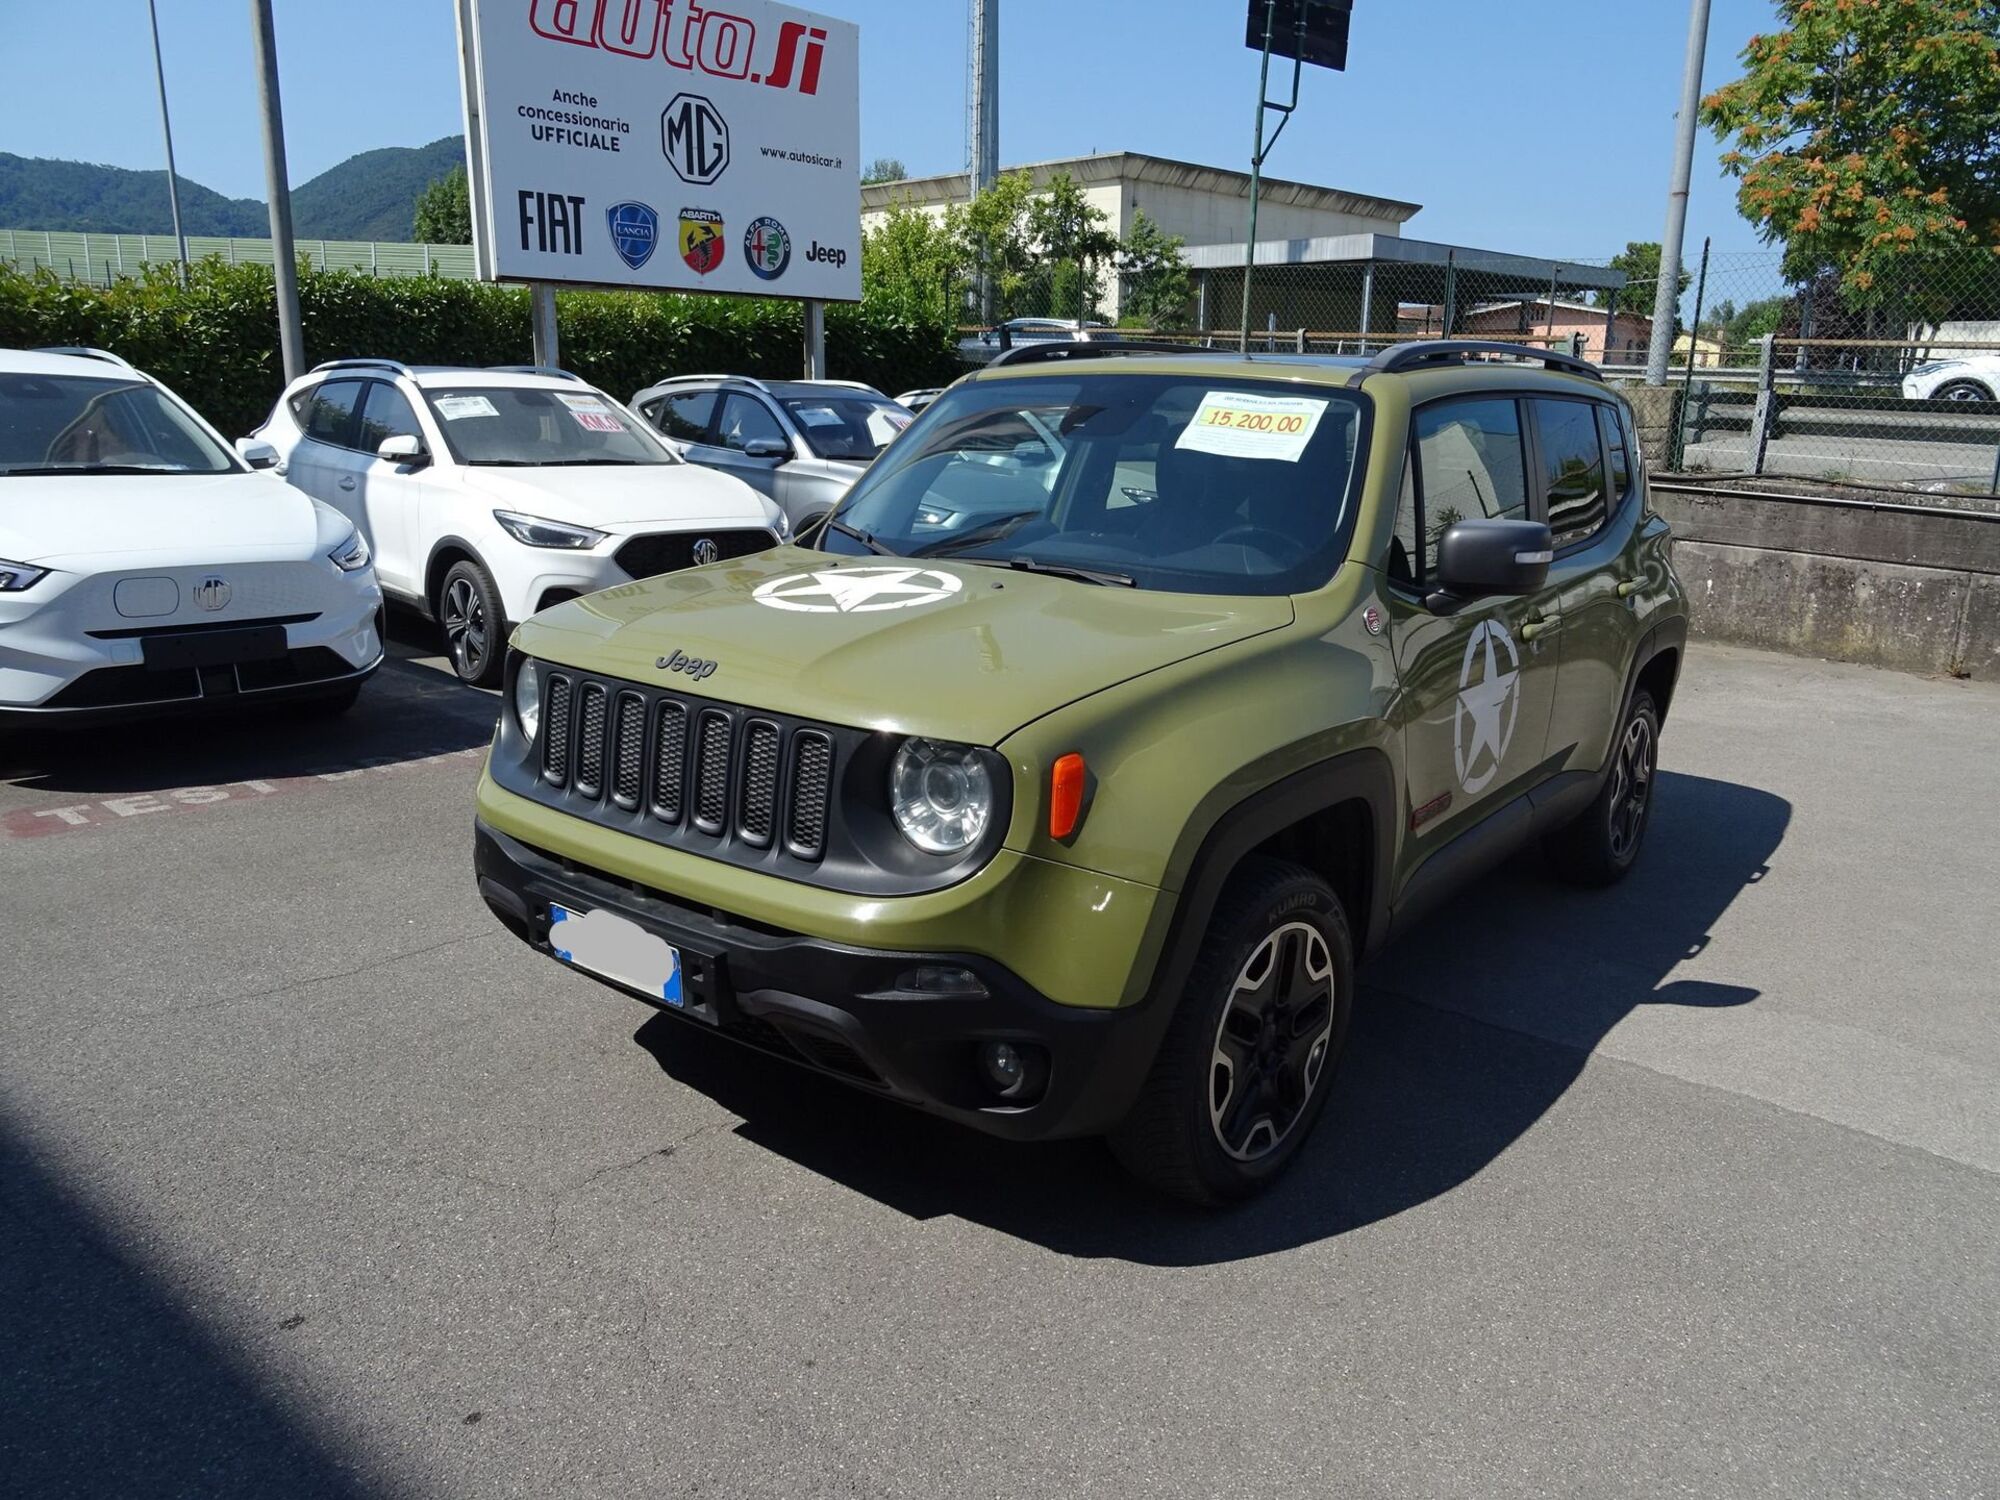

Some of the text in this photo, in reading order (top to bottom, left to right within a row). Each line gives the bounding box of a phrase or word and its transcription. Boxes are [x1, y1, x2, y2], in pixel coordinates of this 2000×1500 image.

[552, 89, 598, 108] Anche
[518, 104, 630, 133] concessionaria
[531, 125, 620, 152] UFFICIALE
[667, 102, 724, 177] MG
[760, 146, 842, 169] www.autosicar.it
[518, 190, 586, 255] FIAT
[680, 210, 721, 222] ABARTH
[617, 226, 650, 237] LANCIA
[745, 218, 791, 252] ALFA ROMEO
[806, 240, 846, 268] Jeep
[1208, 410, 1302, 434] 15.200,00
[656, 649, 718, 681] Jeep
